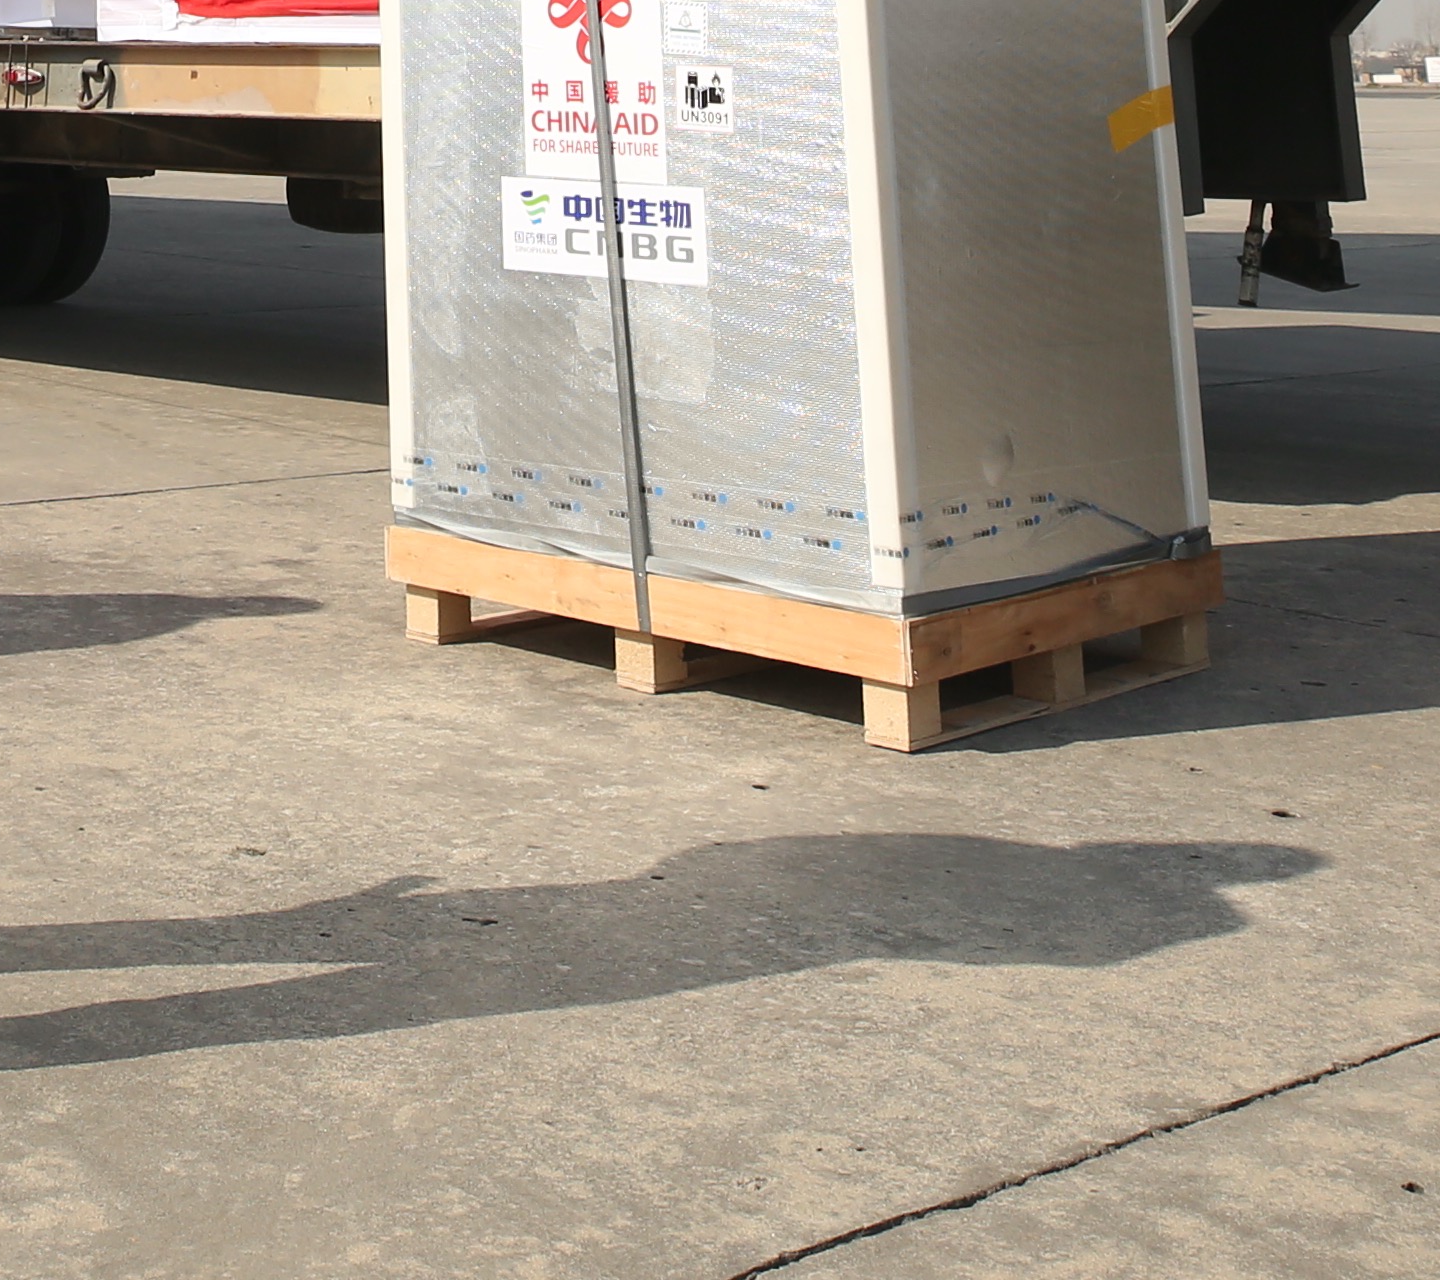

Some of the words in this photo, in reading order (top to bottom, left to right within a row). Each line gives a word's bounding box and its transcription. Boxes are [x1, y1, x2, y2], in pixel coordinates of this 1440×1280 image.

[531, 79, 657, 106] 中国援助
[613, 112, 659, 135] AID
[681, 110, 729, 125] UN3091
[533, 138, 556, 153] FOR
[560, 139, 599, 154] SHARE
[611, 141, 659, 157] FUTURE
[563, 194, 692, 229] 中国生物
[514, 231, 557, 246] 国药集团
